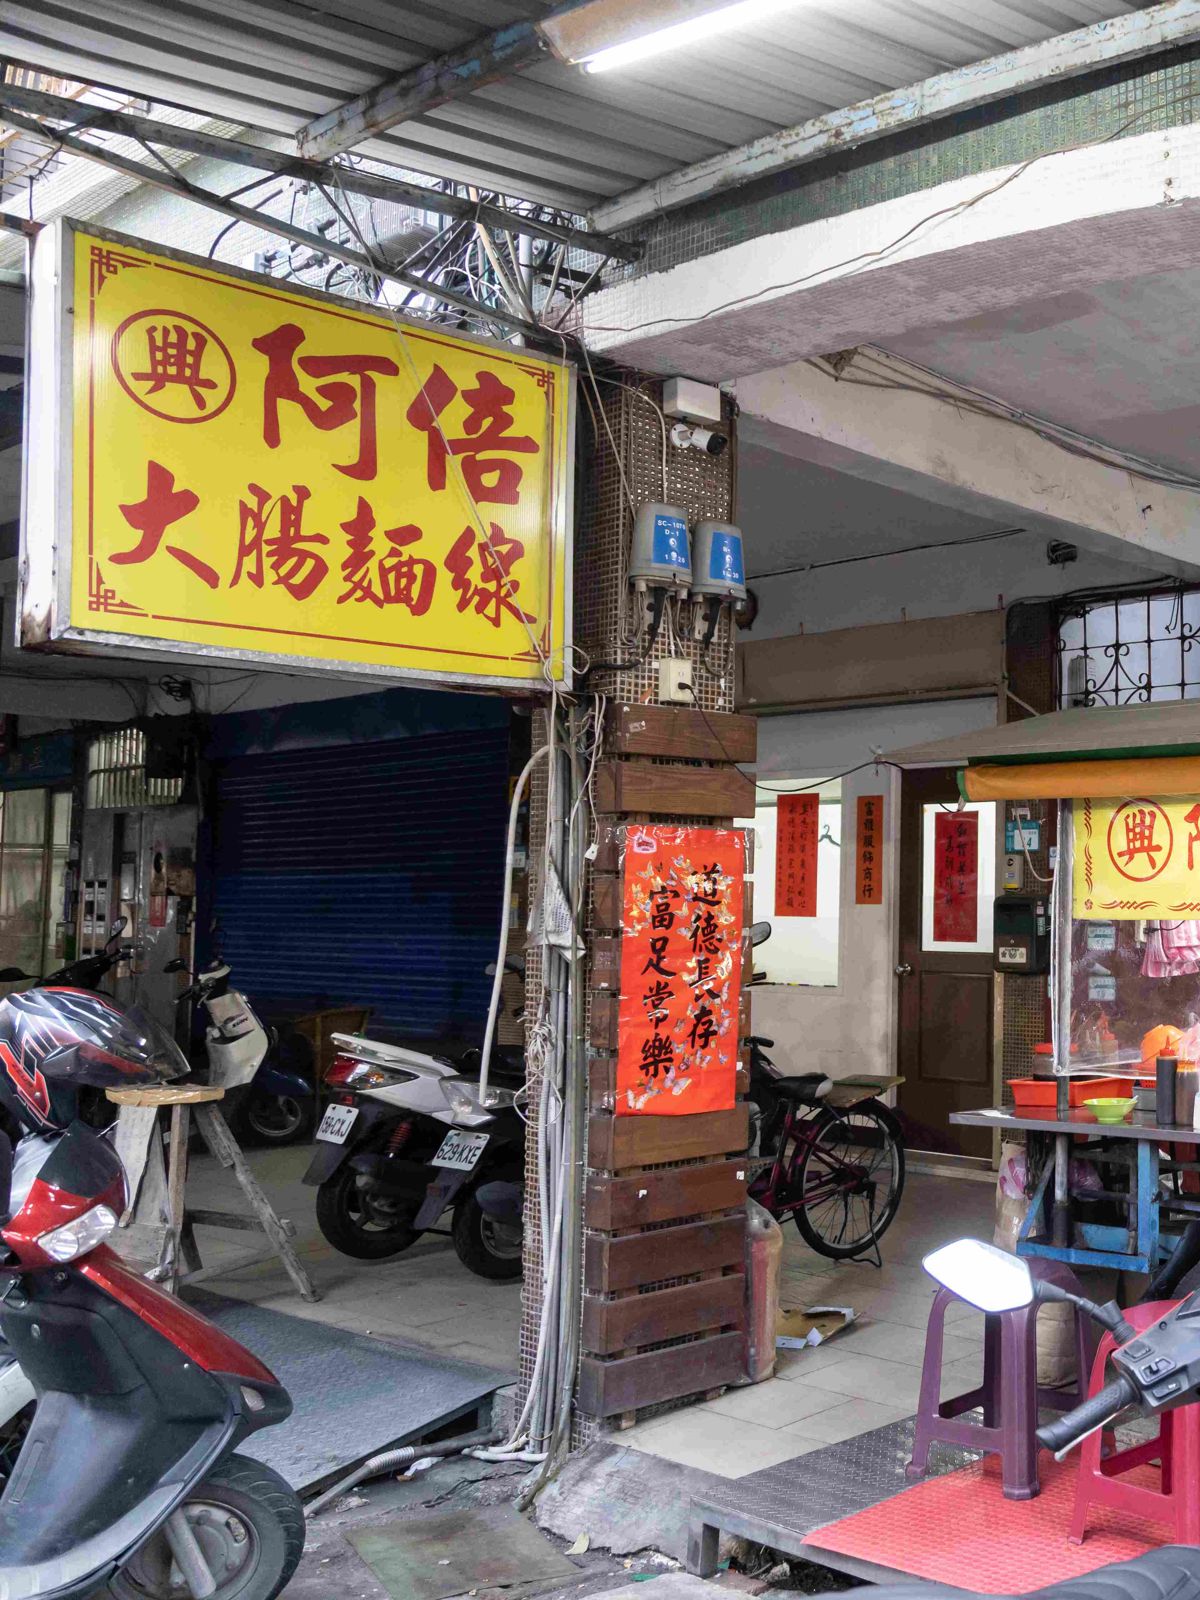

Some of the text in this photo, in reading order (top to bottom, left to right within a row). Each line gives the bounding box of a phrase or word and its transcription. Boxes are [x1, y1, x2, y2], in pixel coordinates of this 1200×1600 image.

[132, 323, 540, 505] 興 阿倍
[109, 460, 537, 628] 大腸麵線
[1117, 810, 1163, 870] 興
[639, 886, 680, 1079] 富足常樂
[688, 863, 723, 1050] 道德長存
